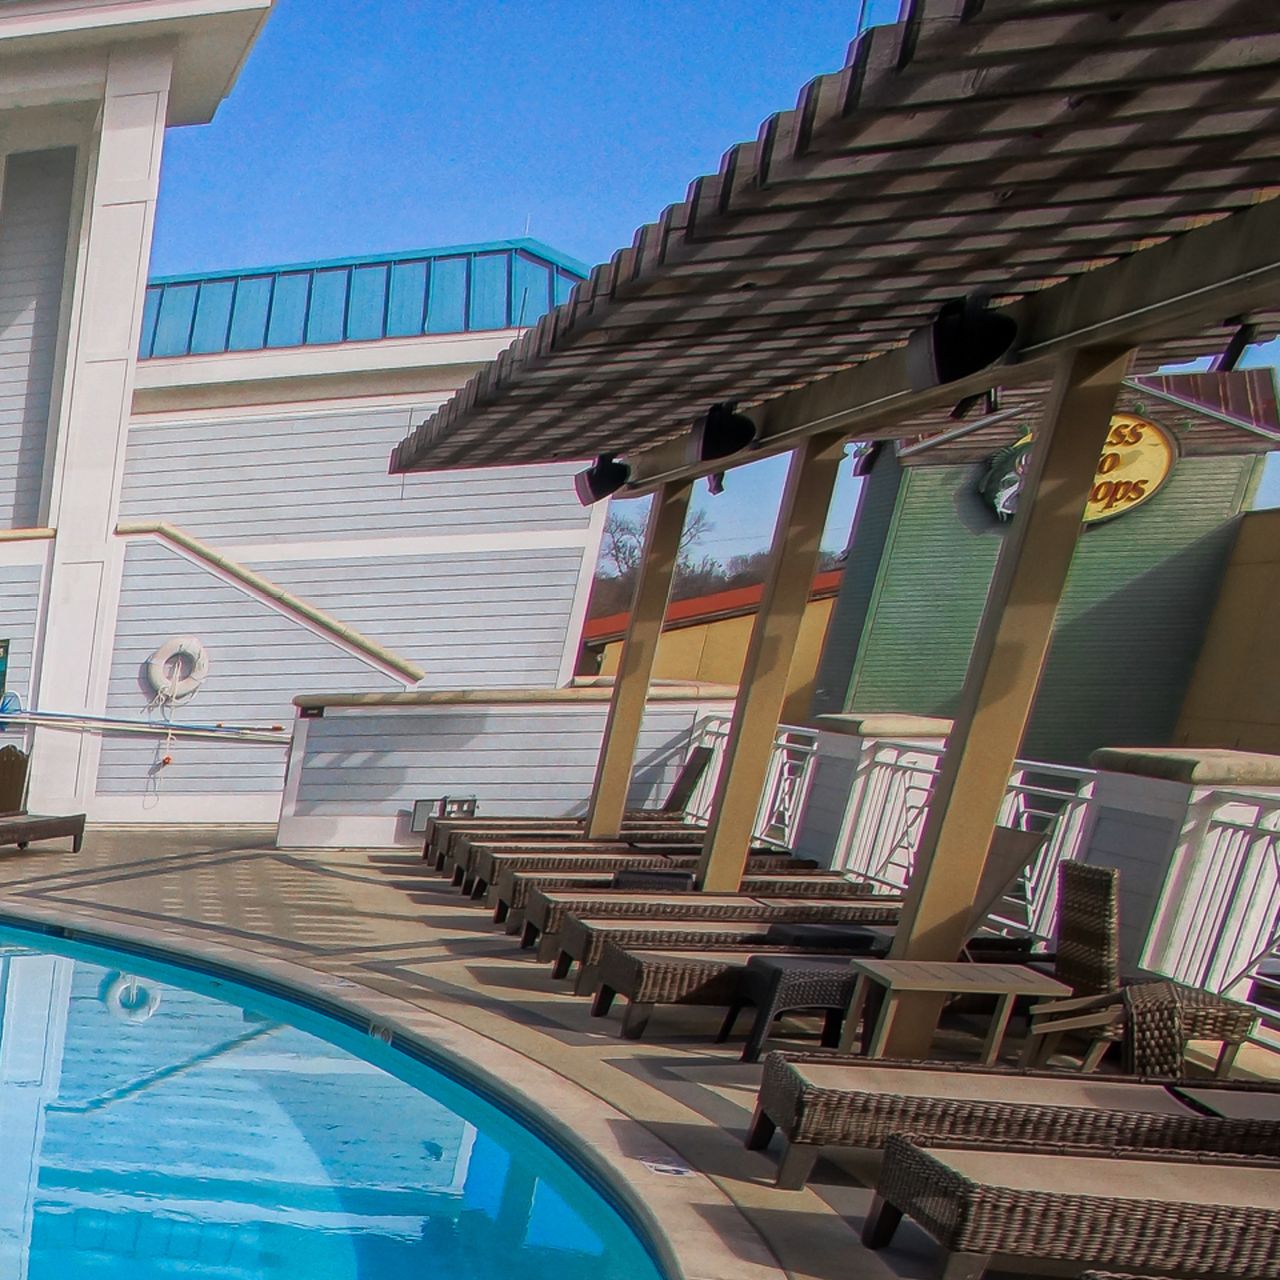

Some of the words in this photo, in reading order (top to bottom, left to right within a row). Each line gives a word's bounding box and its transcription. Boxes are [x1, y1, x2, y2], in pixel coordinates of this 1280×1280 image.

[1104, 423, 1147, 446] ss
[1098, 452, 1121, 474] o
[1088, 479, 1149, 511] ops
